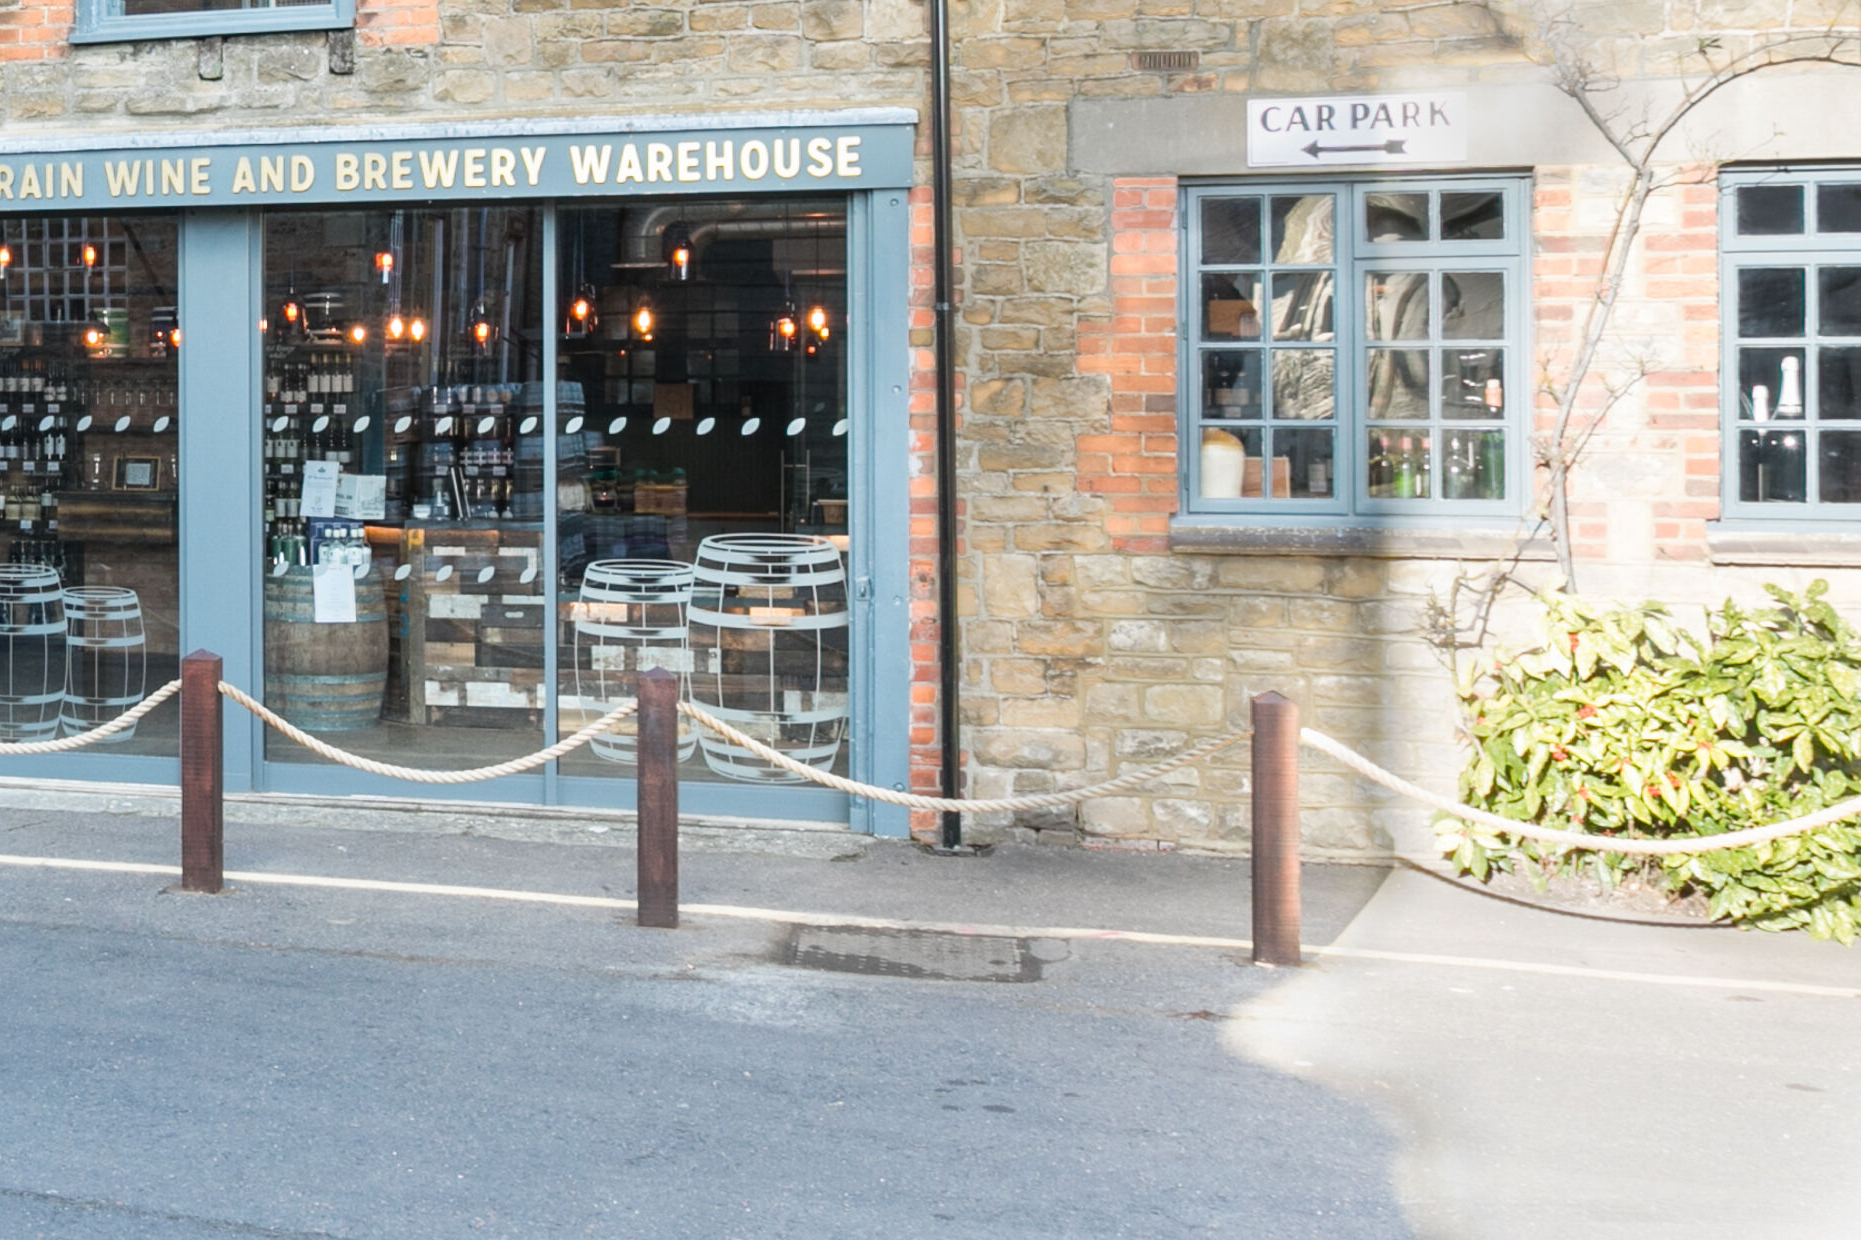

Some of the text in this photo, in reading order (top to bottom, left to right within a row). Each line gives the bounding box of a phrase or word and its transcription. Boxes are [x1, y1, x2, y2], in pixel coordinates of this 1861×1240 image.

[1260, 100, 1451, 133] CAR PARK
[104, 158, 211, 198] WINE
[232, 155, 315, 194] AND
[336, 147, 546, 192] BREWERY
[569, 136, 862, 186] WAREHOUSE
